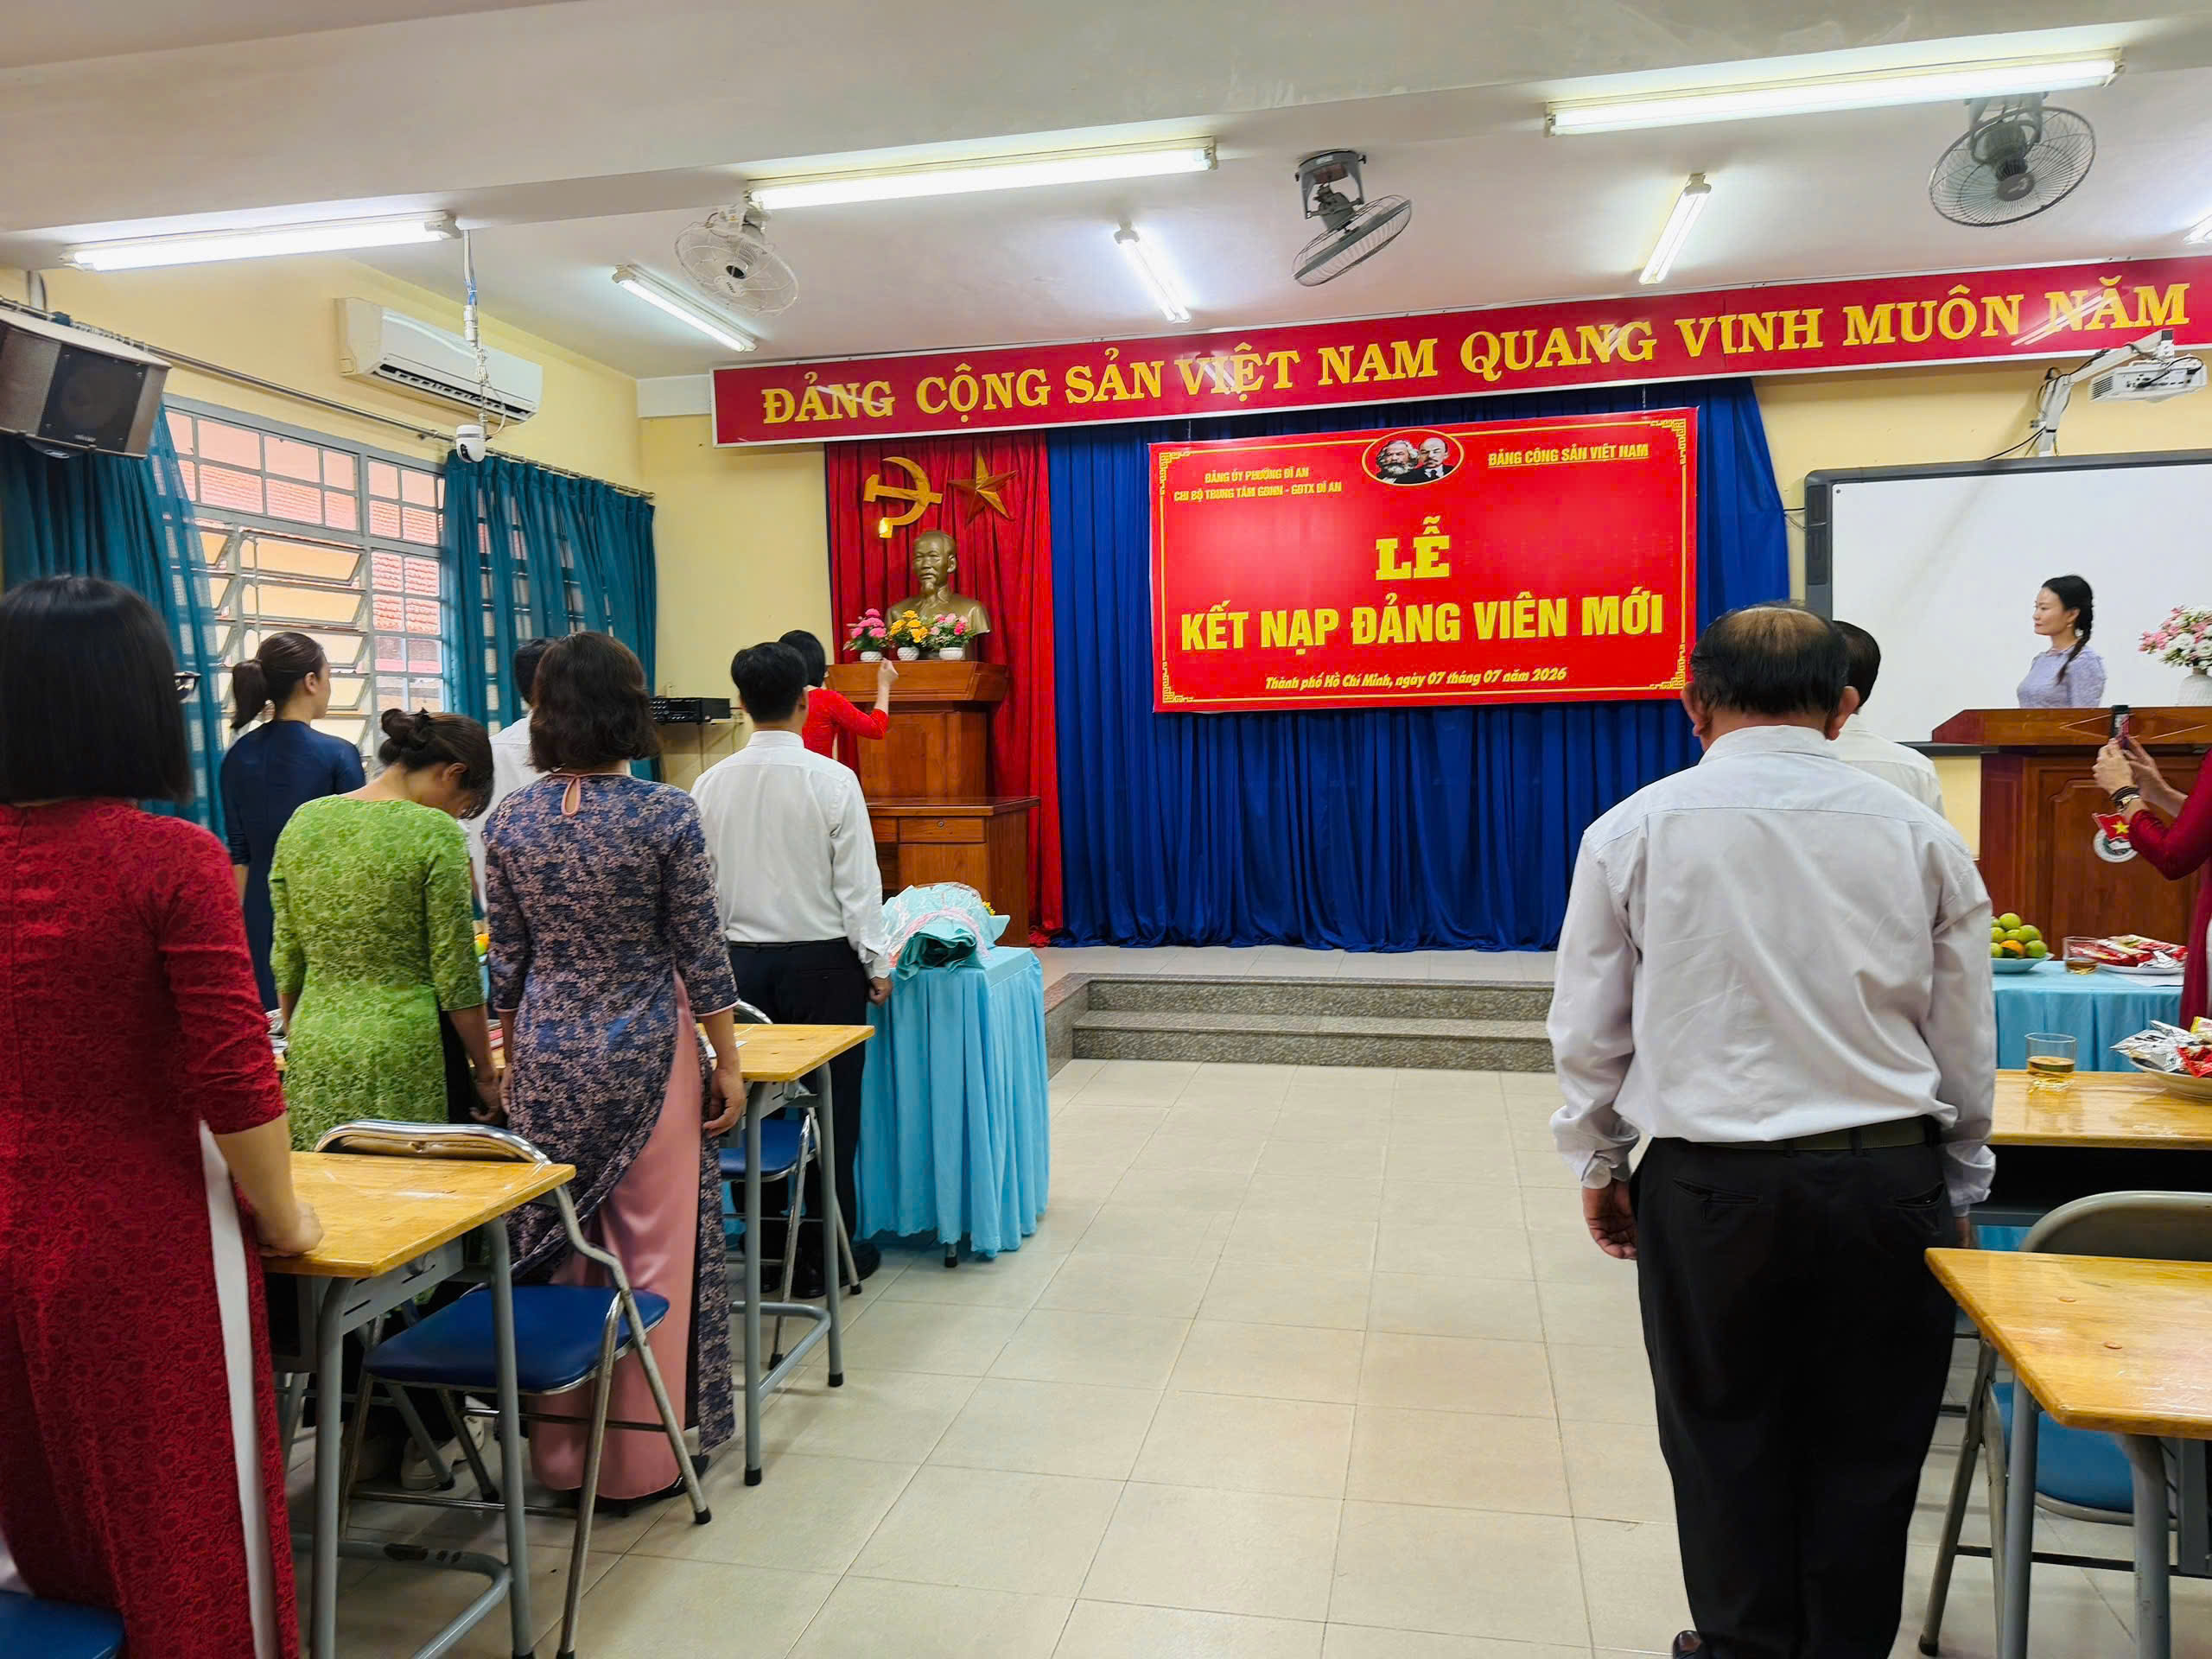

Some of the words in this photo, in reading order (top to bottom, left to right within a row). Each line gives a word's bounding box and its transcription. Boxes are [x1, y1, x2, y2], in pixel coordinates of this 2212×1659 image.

[762, 372, 894, 424] ĐẢNG
[916, 364, 1051, 423] CỘNG
[1065, 347, 1164, 404] SẢN
[1174, 344, 1300, 403] VIỆT
[1317, 338, 1438, 385] NAM
[1460, 320, 1656, 383] QUANG
[1675, 307, 1823, 358] VINH
[1843, 283, 2024, 346] MUÔN
[2044, 276, 2190, 332] NĂM
[1488, 448, 1522, 466] ĐẢNG
[1525, 447, 1559, 465] CỘNG
[1560, 443, 1587, 461] SẢN
[1590, 443, 1617, 461] VIỆT
[1618, 443, 1649, 458] NAM
[1205, 470, 1230, 484] ĐẢNG
[1295, 467, 1309, 478] AN
[1173, 491, 1189, 502] CHI
[1191, 489, 1204, 502] BỘ
[1205, 488, 1234, 500] TRUNG
[1236, 486, 1255, 499] TÂM
[1328, 482, 1342, 493] AN
[1375, 515, 1452, 581] LỄ
[1180, 599, 1249, 652] KẾT
[1260, 608, 1339, 656] NẠP
[1351, 592, 1460, 645] ĐẢNG
[1473, 592, 1568, 640] VIÊN
[1580, 587, 1663, 636] MỚI
[1265, 676, 1300, 690] Thành
[1300, 672, 1325, 691] phố
[1324, 671, 1341, 689] Hồ
[1342, 672, 1363, 688] Chí
[1362, 673, 1393, 689] Minh,
[1395, 672, 1426, 689] ngày
[1427, 671, 1446, 684] 07
[1446, 670, 1482, 686] tháng
[1484, 669, 1503, 683] 07
[1502, 669, 1530, 683] năm
[1530, 666, 1568, 682] 2026
